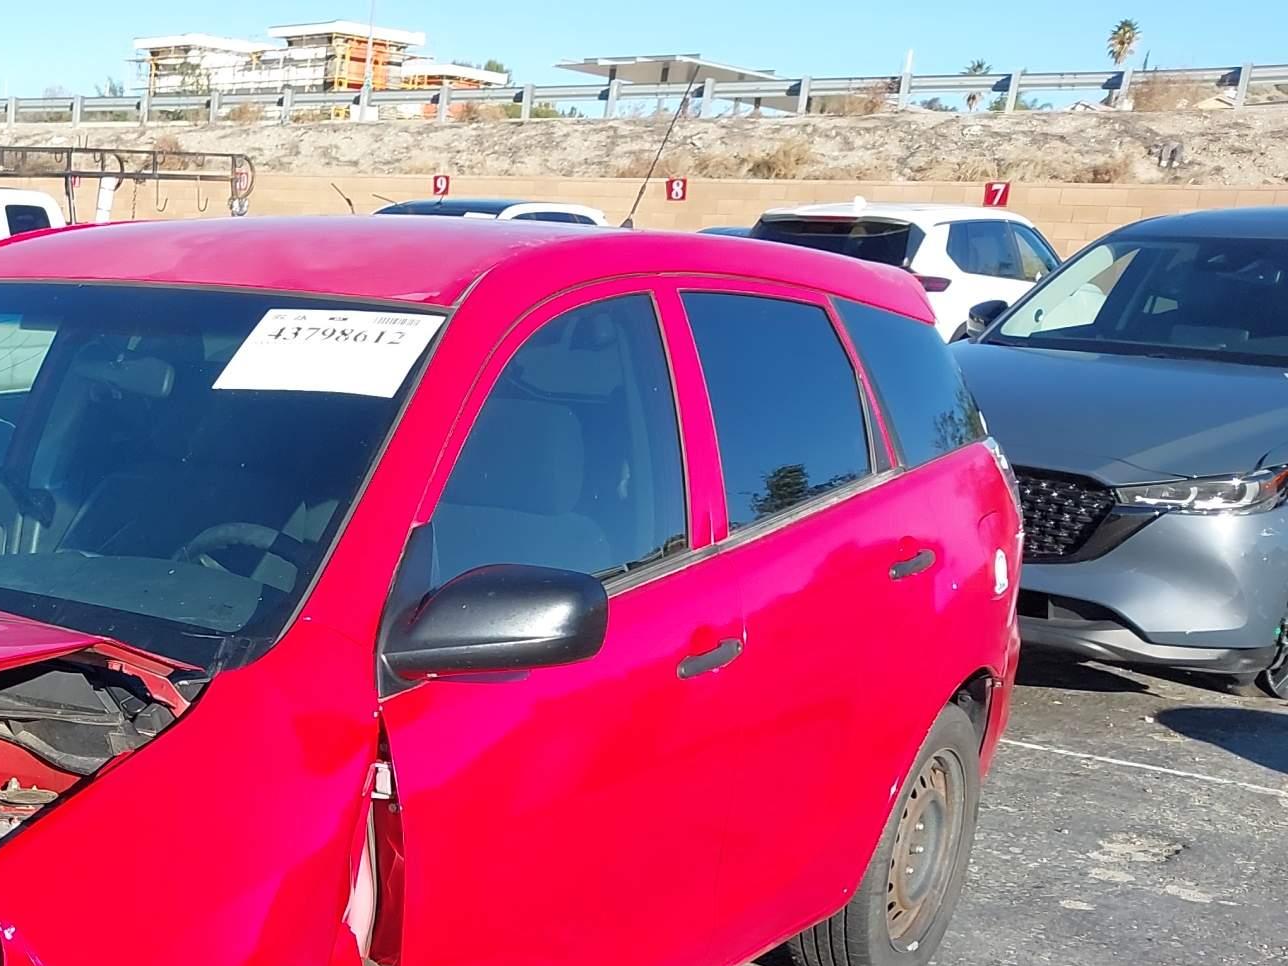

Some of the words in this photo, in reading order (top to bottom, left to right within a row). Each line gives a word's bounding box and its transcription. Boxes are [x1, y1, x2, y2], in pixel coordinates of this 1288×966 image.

[436, 176, 447, 194] 9
[671, 179, 684, 199] 8
[991, 183, 1006, 205] 7
[268, 326, 406, 345] 43798612
